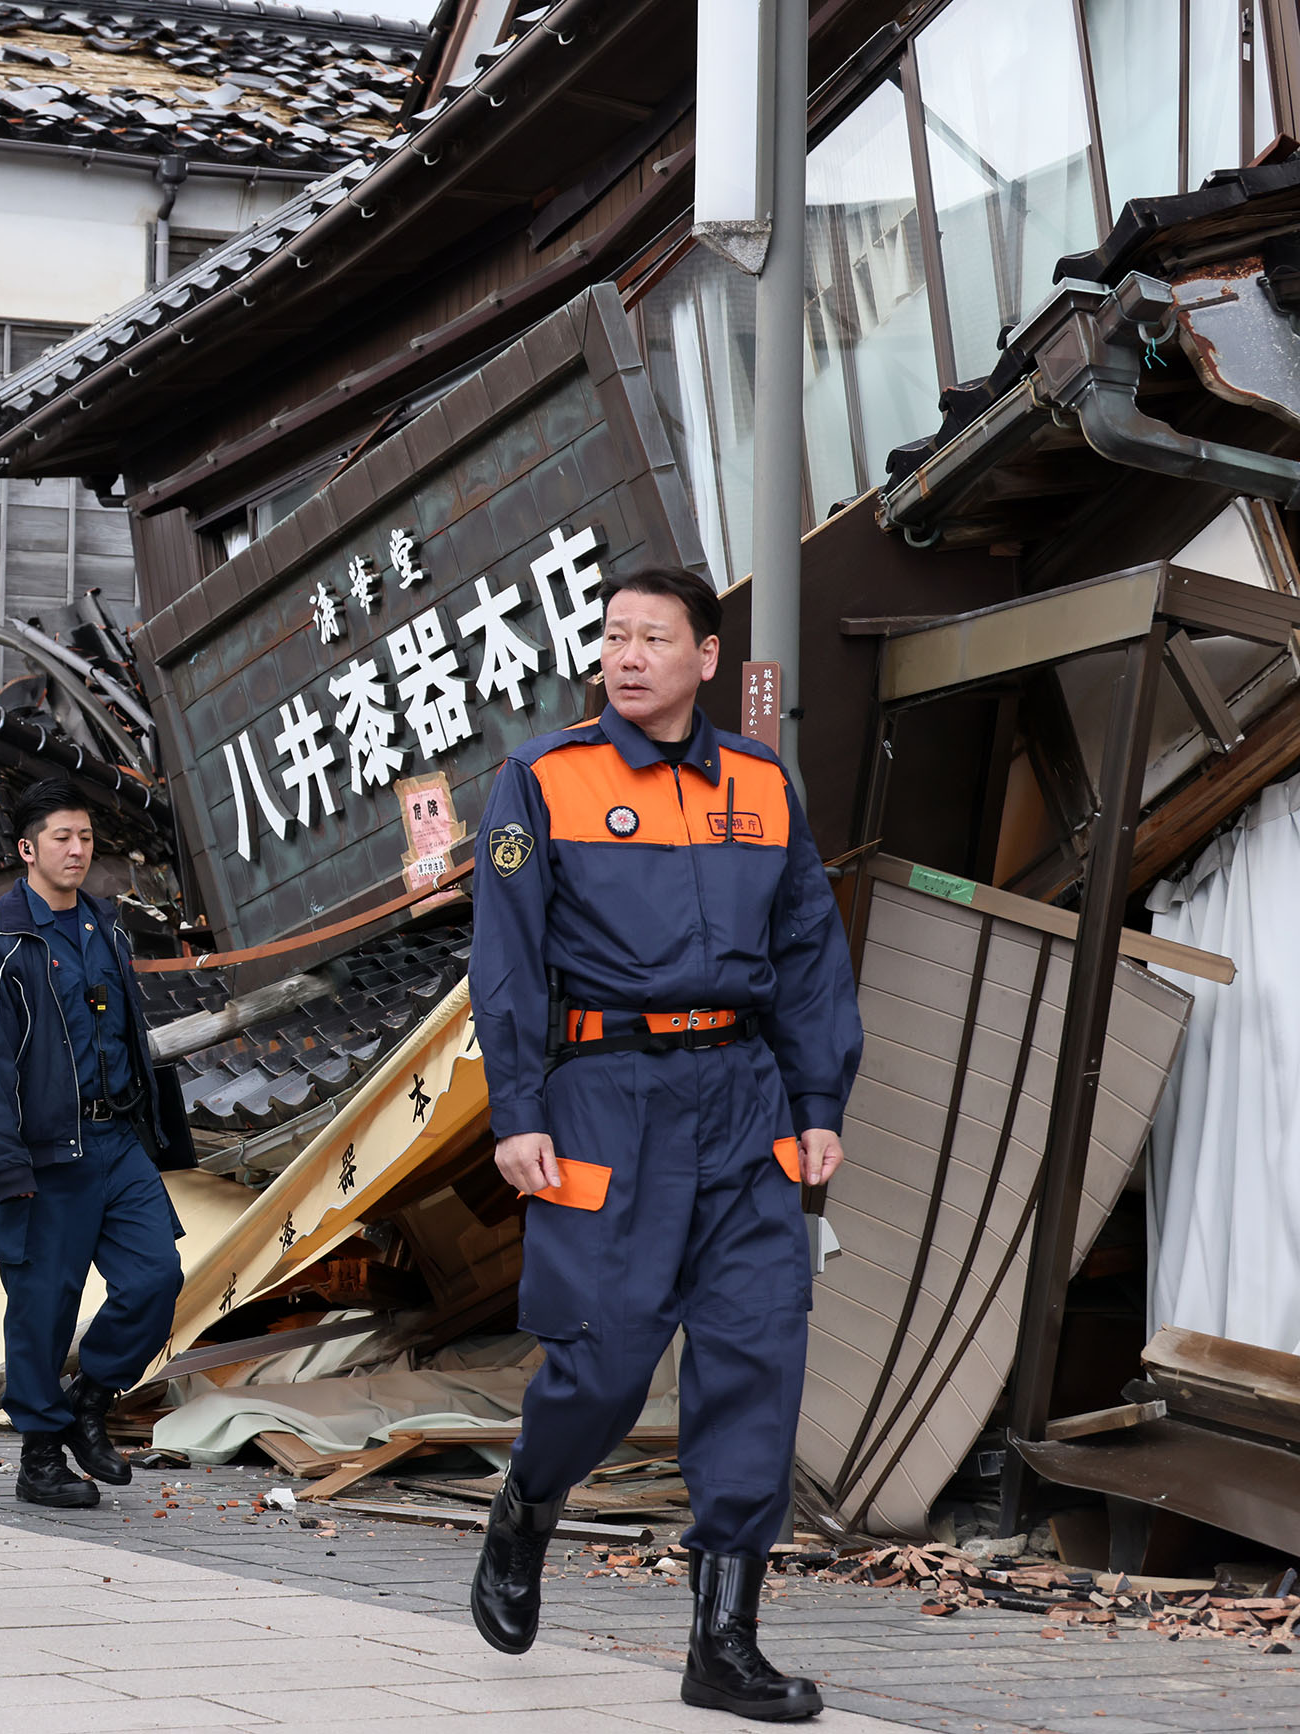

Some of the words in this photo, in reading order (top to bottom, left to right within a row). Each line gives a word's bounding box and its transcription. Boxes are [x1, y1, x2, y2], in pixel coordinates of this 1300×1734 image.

[222, 525, 604, 862] 八井漆器本店
[413, 799, 439, 820] 危険
